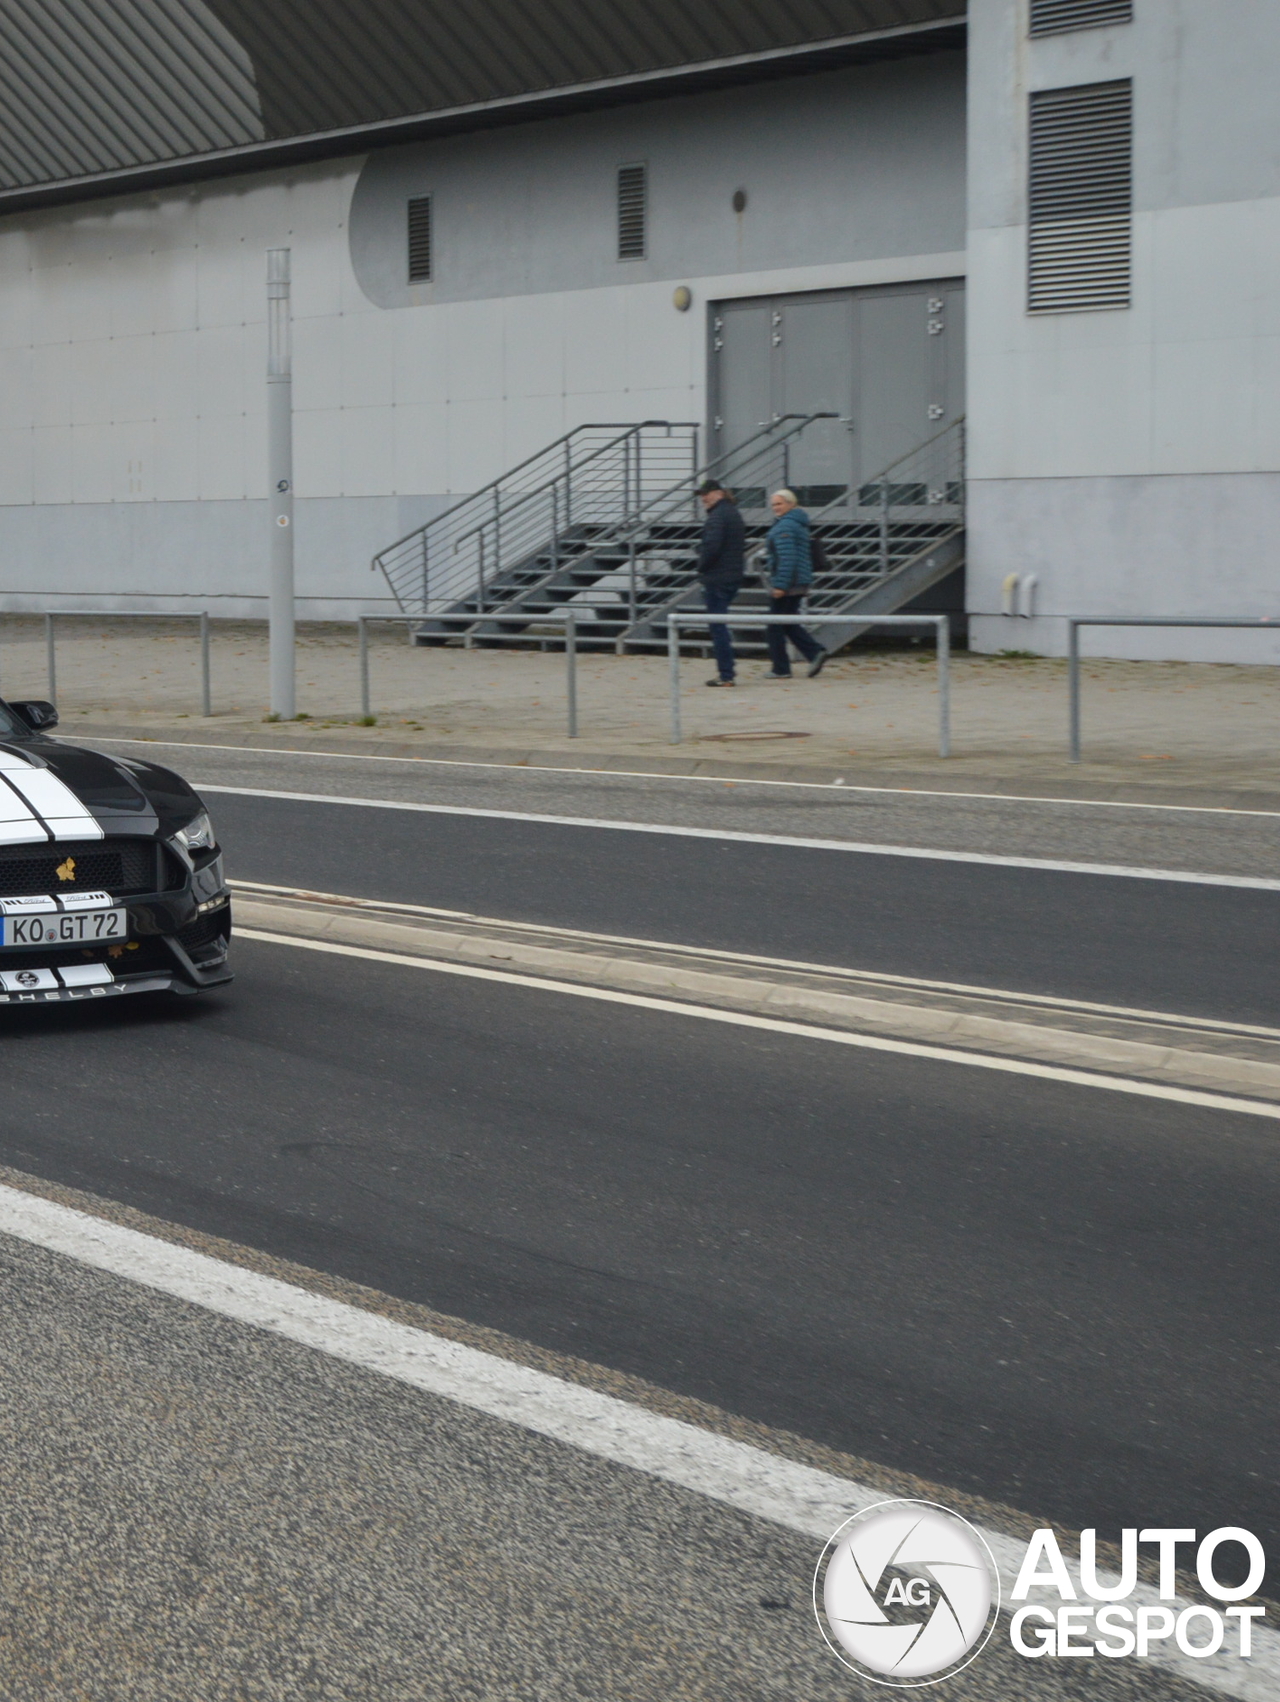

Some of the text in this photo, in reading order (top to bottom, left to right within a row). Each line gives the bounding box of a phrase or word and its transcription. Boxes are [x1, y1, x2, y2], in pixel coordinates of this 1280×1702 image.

[13, 918, 44, 943] KO
[60, 915, 88, 940] GT
[93, 913, 118, 937] 72
